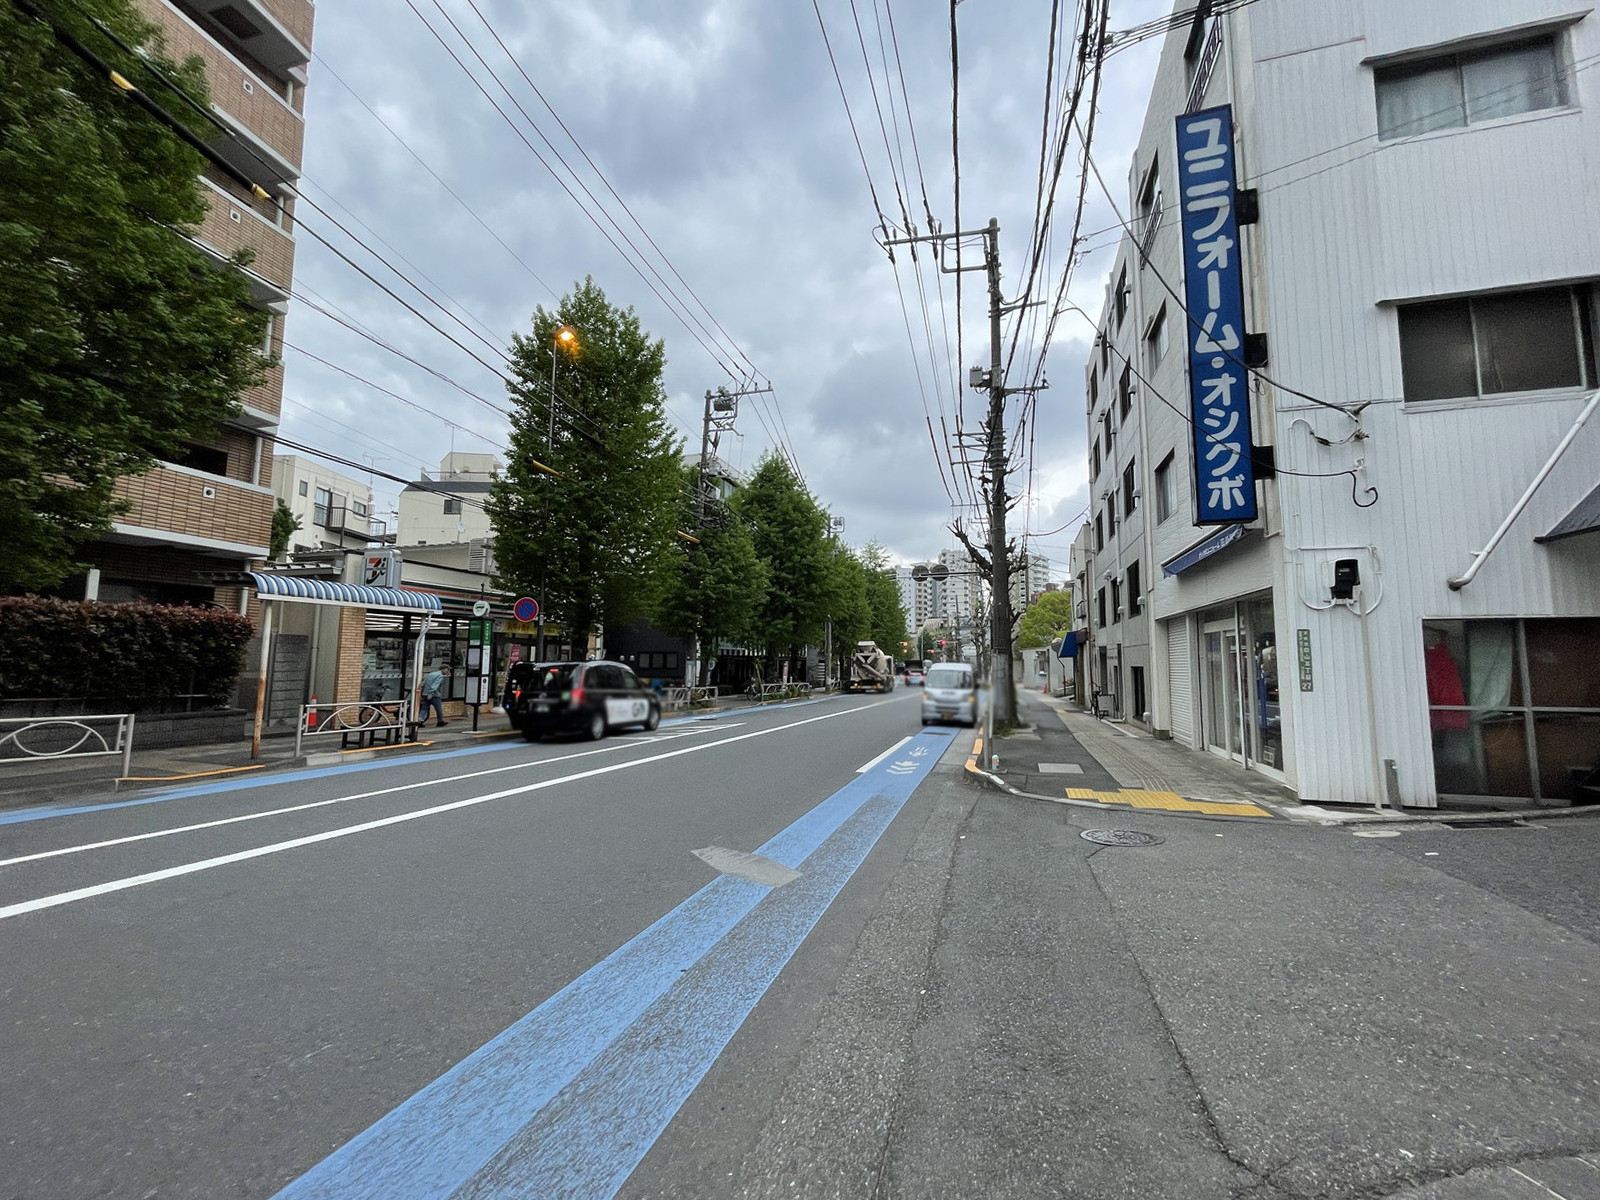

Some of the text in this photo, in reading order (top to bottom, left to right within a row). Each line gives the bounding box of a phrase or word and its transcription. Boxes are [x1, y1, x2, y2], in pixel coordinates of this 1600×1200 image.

[1184, 118, 1246, 510] ユニフォーム・オシクボ
